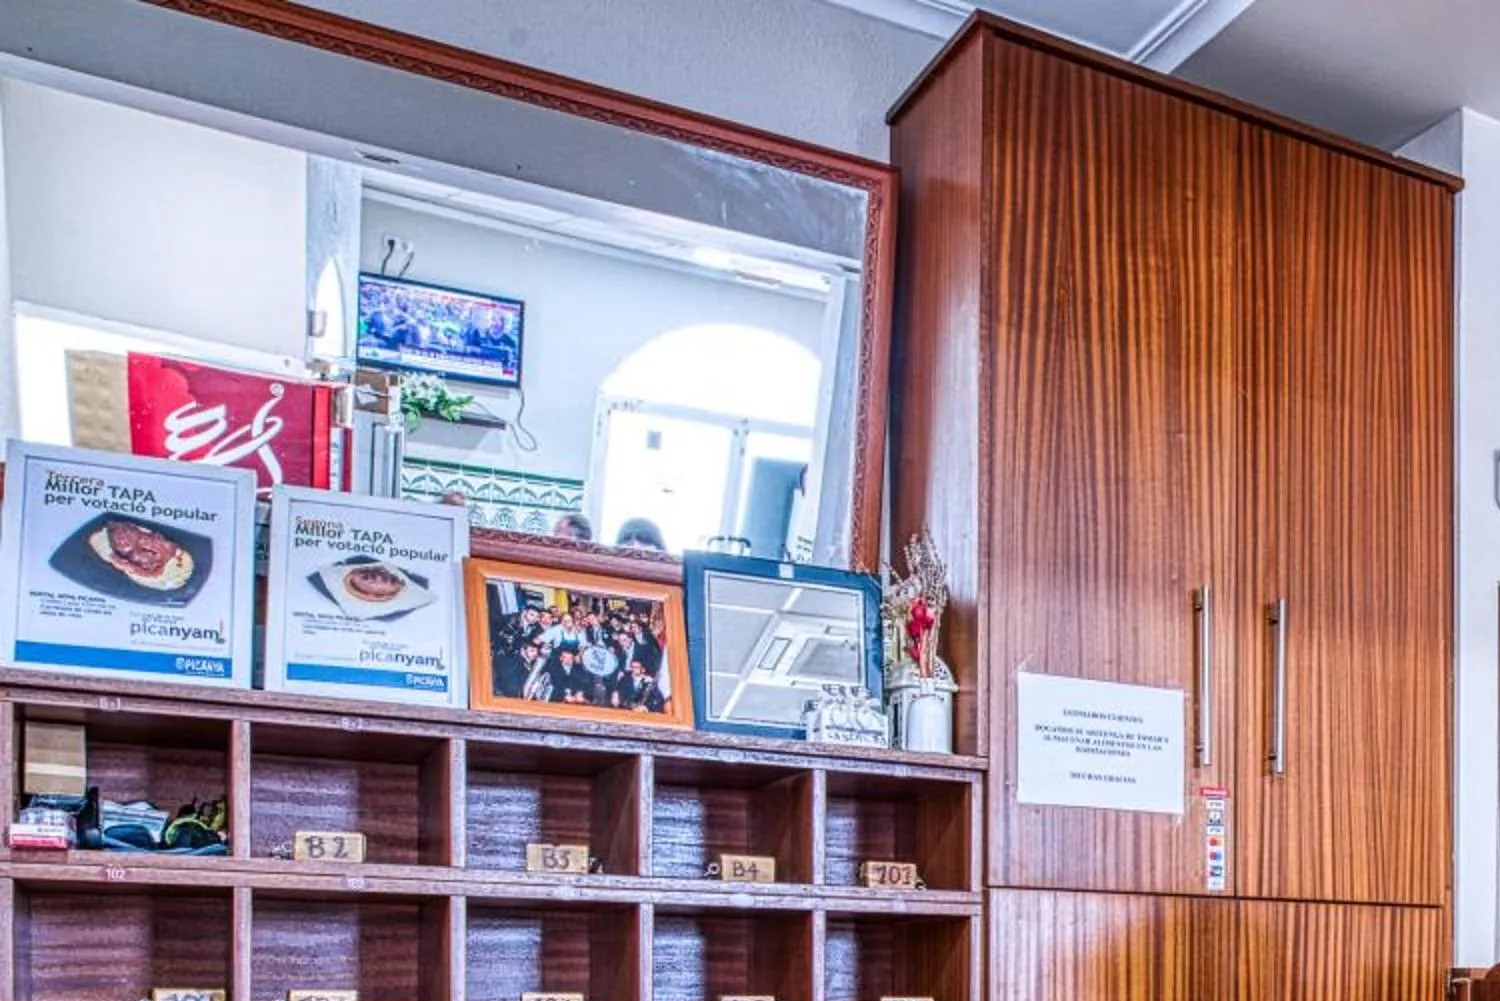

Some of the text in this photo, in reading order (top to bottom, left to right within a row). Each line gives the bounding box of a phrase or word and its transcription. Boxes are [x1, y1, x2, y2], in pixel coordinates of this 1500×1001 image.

[45, 479, 156, 502] Millor TAPA
[44, 493, 219, 522] per votació popular
[295, 525, 394, 545] Millor TAPA
[294, 537, 449, 562] per votació popular
[541, 847, 570, 869] B3
[732, 861, 760, 880] B4
